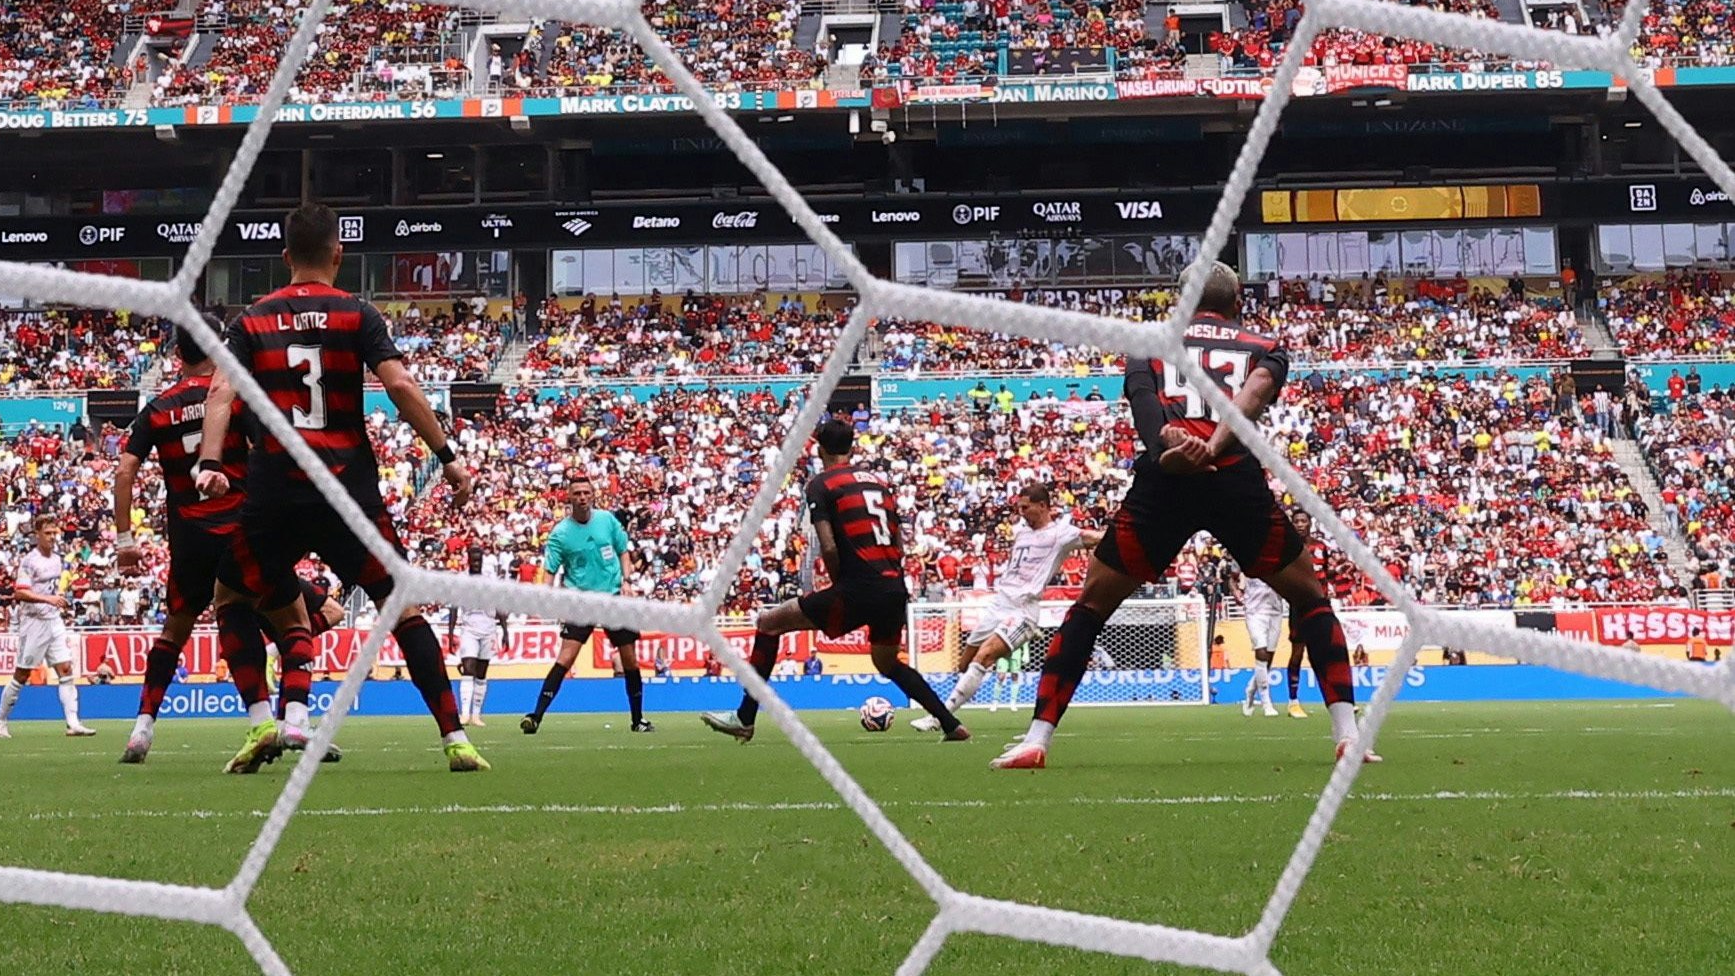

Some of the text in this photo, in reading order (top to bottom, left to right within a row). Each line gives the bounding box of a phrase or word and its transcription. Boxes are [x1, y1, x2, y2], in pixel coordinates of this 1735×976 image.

[1462, 72, 1526, 90] DUPER
[1535, 71, 1563, 88] 85
[991, 85, 1109, 102] DAN MARINO
[310, 101, 436, 122] OFFERDAHL 56
[560, 93, 741, 114] MARK CLAYTO 83
[51, 110, 121, 128] BETTERS
[124, 109, 148, 126] 75
[1635, 189, 1650, 198] DA
[1115, 200, 1163, 219] VISA
[1636, 198, 1651, 207] ZN
[481, 219, 513, 228] ULTRA
[633, 215, 680, 229] Betano
[872, 210, 920, 223] Lenovo
[974, 205, 1000, 222] PIF
[1033, 202, 1081, 219] QATAR
[1046, 212, 1082, 222] AIRWAYS
[236, 223, 282, 240] VISA
[344, 219, 359, 230] DA
[409, 220, 442, 234] airbnb
[1, 231, 48, 244] Lenovo
[99, 226, 125, 243] PIF
[344, 229, 359, 239] ZN
[277, 312, 328, 331] L. ORTIZ
[286, 344, 328, 430] 3
[52, 400, 68, 411] 129
[862, 490, 892, 546] 5
